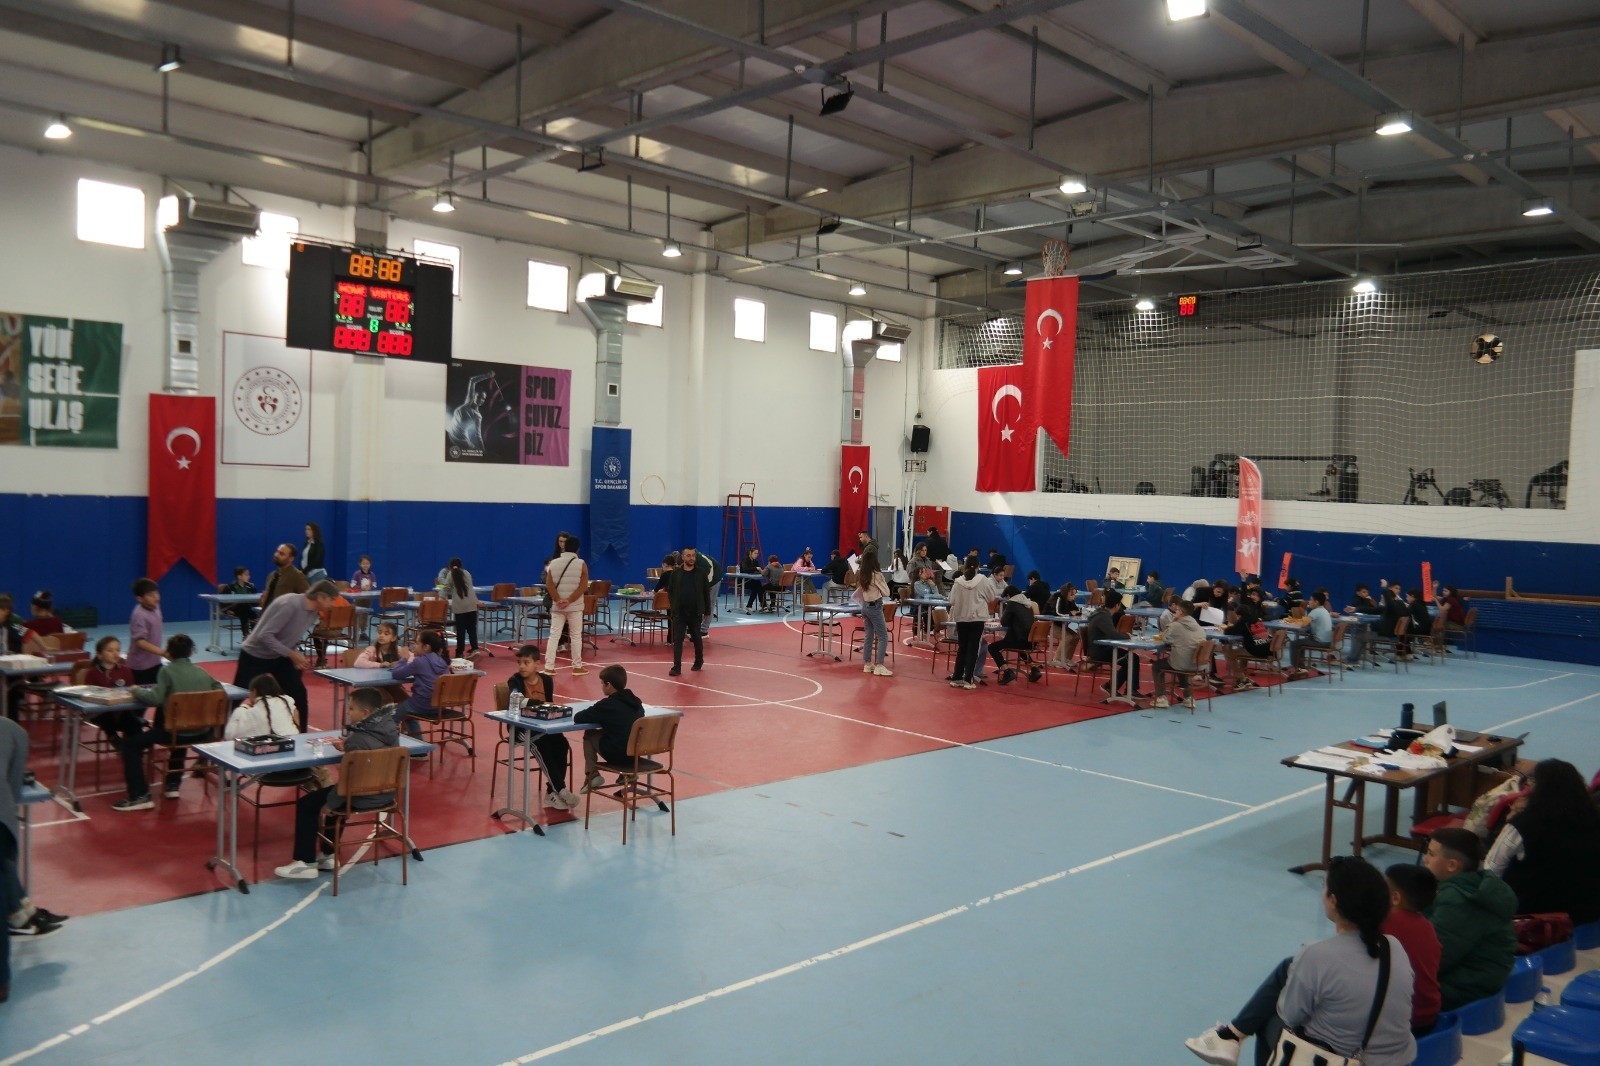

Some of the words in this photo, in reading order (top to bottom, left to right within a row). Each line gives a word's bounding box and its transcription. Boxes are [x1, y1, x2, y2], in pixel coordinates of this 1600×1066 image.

[349, 254, 401, 281] 88:88
[339, 295, 365, 318] 88
[385, 300, 409, 323] 88
[369, 318, 379, 333] 8
[334, 326, 371, 350] 888
[377, 331, 412, 355] 888
[525, 375, 556, 400] SPOR
[28, 398, 85, 434] ULAŞ
[525, 404, 562, 429] CUYUZ
